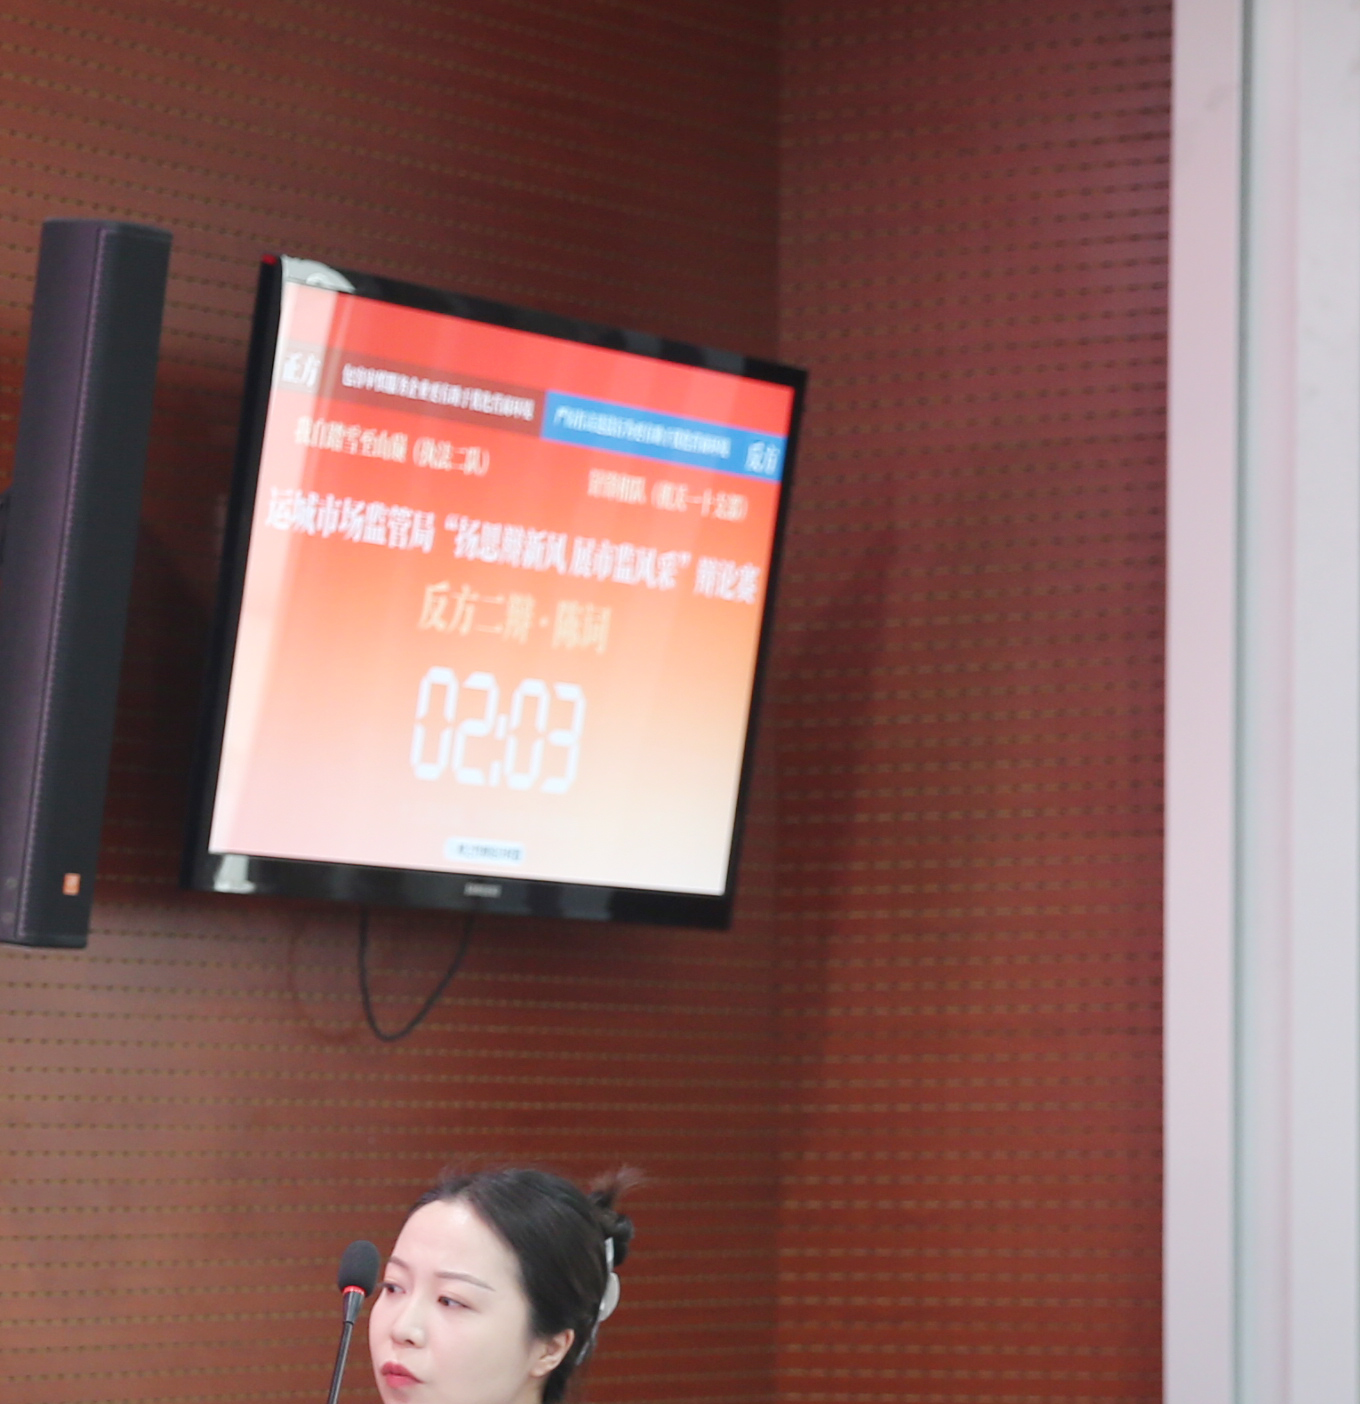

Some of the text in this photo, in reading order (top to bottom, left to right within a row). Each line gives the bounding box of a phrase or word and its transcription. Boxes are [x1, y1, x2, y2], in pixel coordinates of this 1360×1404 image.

[281, 352, 321, 387] 正方
[745, 440, 781, 476] 反方
[410, 665, 586, 794] 02:03
